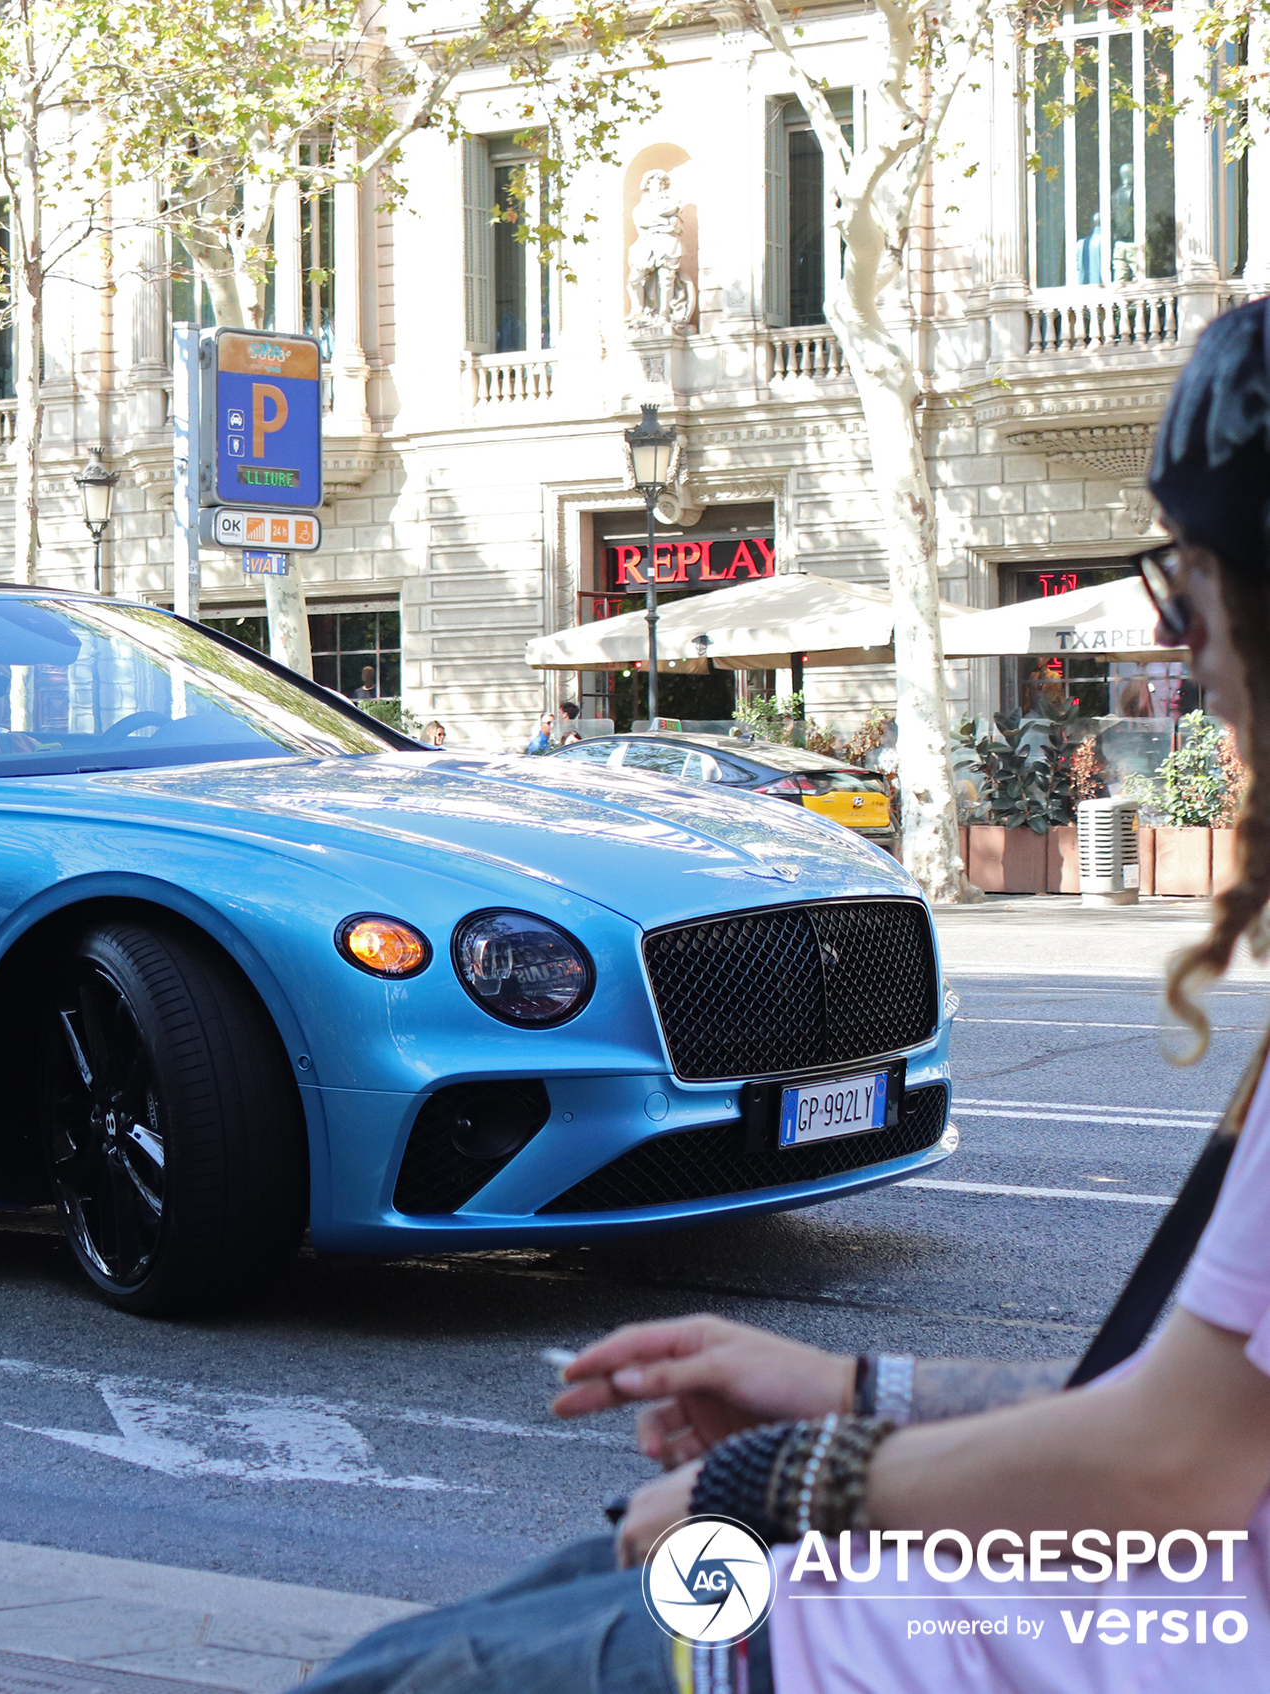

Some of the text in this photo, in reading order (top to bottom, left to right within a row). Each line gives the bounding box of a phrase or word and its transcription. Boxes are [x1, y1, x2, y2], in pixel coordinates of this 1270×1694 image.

[252, 383, 288, 458] P
[247, 470, 294, 487] LLIURE
[222, 518, 240, 532] OK
[273, 525, 287, 536] 24 h
[615, 538, 775, 585] REPLAY
[1055, 629, 1158, 650] TXAPEL
